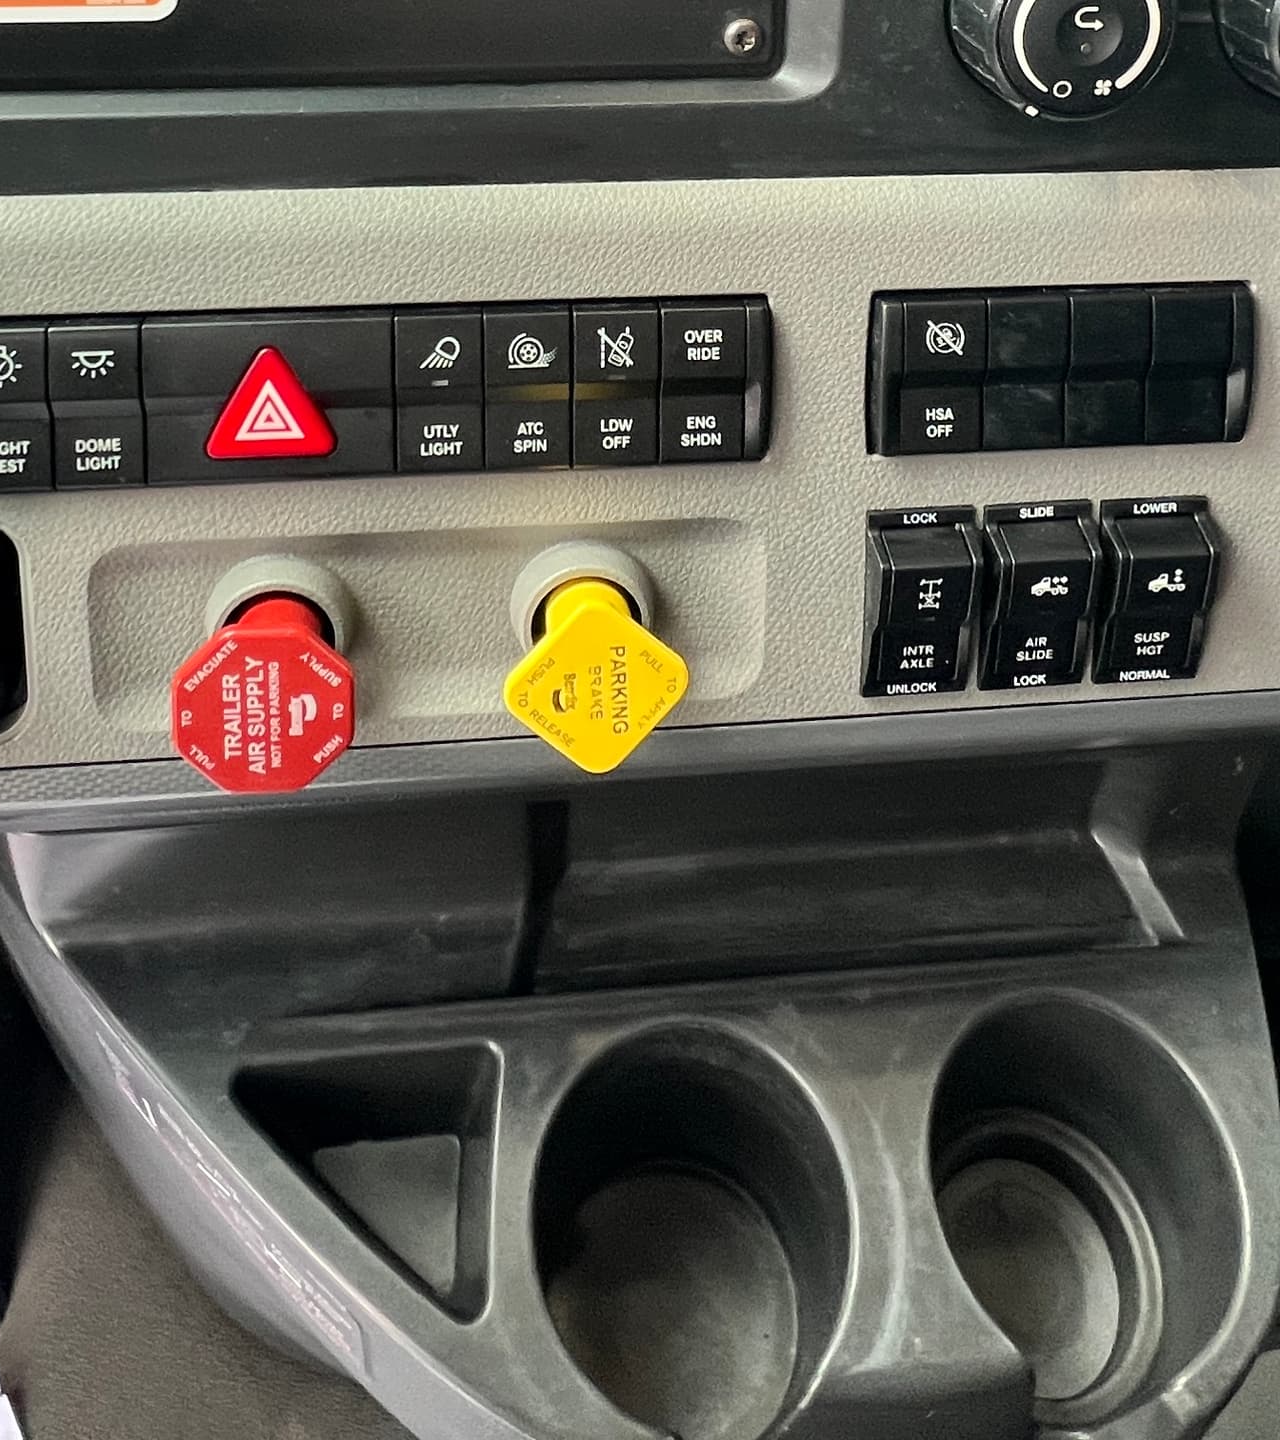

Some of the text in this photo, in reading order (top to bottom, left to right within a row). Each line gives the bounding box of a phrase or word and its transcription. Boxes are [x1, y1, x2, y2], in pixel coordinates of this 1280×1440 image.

[684, 328, 723, 344] OVER
[687, 346, 721, 361] RIDE
[925, 408, 954, 421] HSA
[517, 421, 544, 437] ATC
[600, 418, 633, 434] LDW
[686, 415, 716, 431] ENG
[926, 424, 953, 438] OFF
[423, 424, 459, 440] UTLY
[680, 432, 722, 448] SHDN
[75, 438, 121, 454] DOME
[420, 441, 463, 457] LIGHT
[513, 438, 548, 454] SPIN
[602, 434, 632, 450] OFF
[75, 455, 121, 472] LIGHT
[1019, 505, 1054, 519] SLIDE
[1133, 502, 1177, 515] LOWER
[903, 512, 938, 525] LOCK
[1025, 636, 1047, 648] AIR
[1134, 632, 1170, 644] SUSP
[903, 645, 934, 657] INTR
[1016, 648, 1054, 661] SLIDE
[1136, 644, 1164, 657] HGT
[900, 657, 934, 669] AXLE
[640, 650, 663, 674] PULL
[666, 678, 677, 693] TO
[1119, 669, 1170, 681] NORMAL
[887, 681, 937, 694] UNLOCK
[1013, 674, 1046, 687] LOCK
[589, 665, 604, 720] BRAKE
[610, 646, 629, 734] PARKING
[181, 640, 238, 771] PULL TO EVACUATE
[299, 652, 344, 763] PUSH TO SUPPLY
[518, 658, 575, 748] PUSH TO RELEASE
[222, 673, 242, 760] TRAILER
[245, 656, 266, 775] AIR SUPPLY
[268, 661, 282, 768] NOT FOR PARKING
